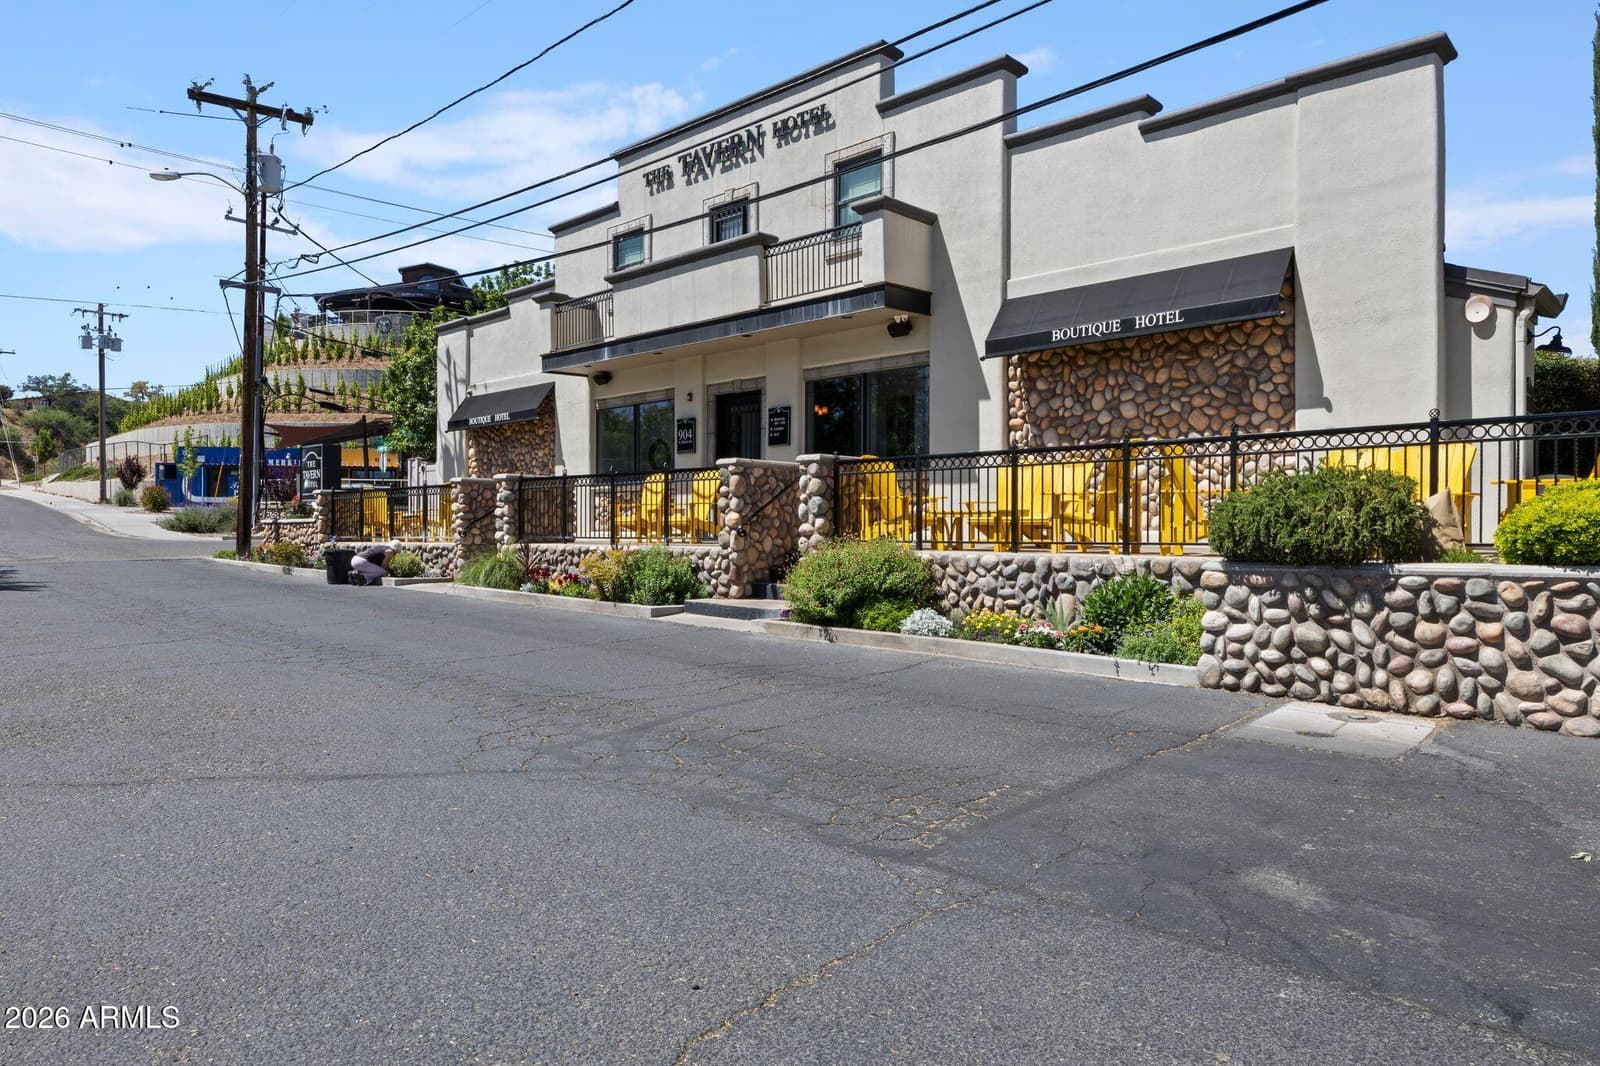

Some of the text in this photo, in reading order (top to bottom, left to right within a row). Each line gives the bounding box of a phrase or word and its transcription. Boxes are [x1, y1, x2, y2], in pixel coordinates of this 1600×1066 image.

[643, 103, 832, 189] THE TAVERN HOTEL
[1051, 309, 1185, 342] BOUTIQUE HOTEL
[468, 412, 511, 426] BOUTIQUE HOTEL
[678, 429, 693, 441] 904
[267, 459, 301, 467] MERKI
